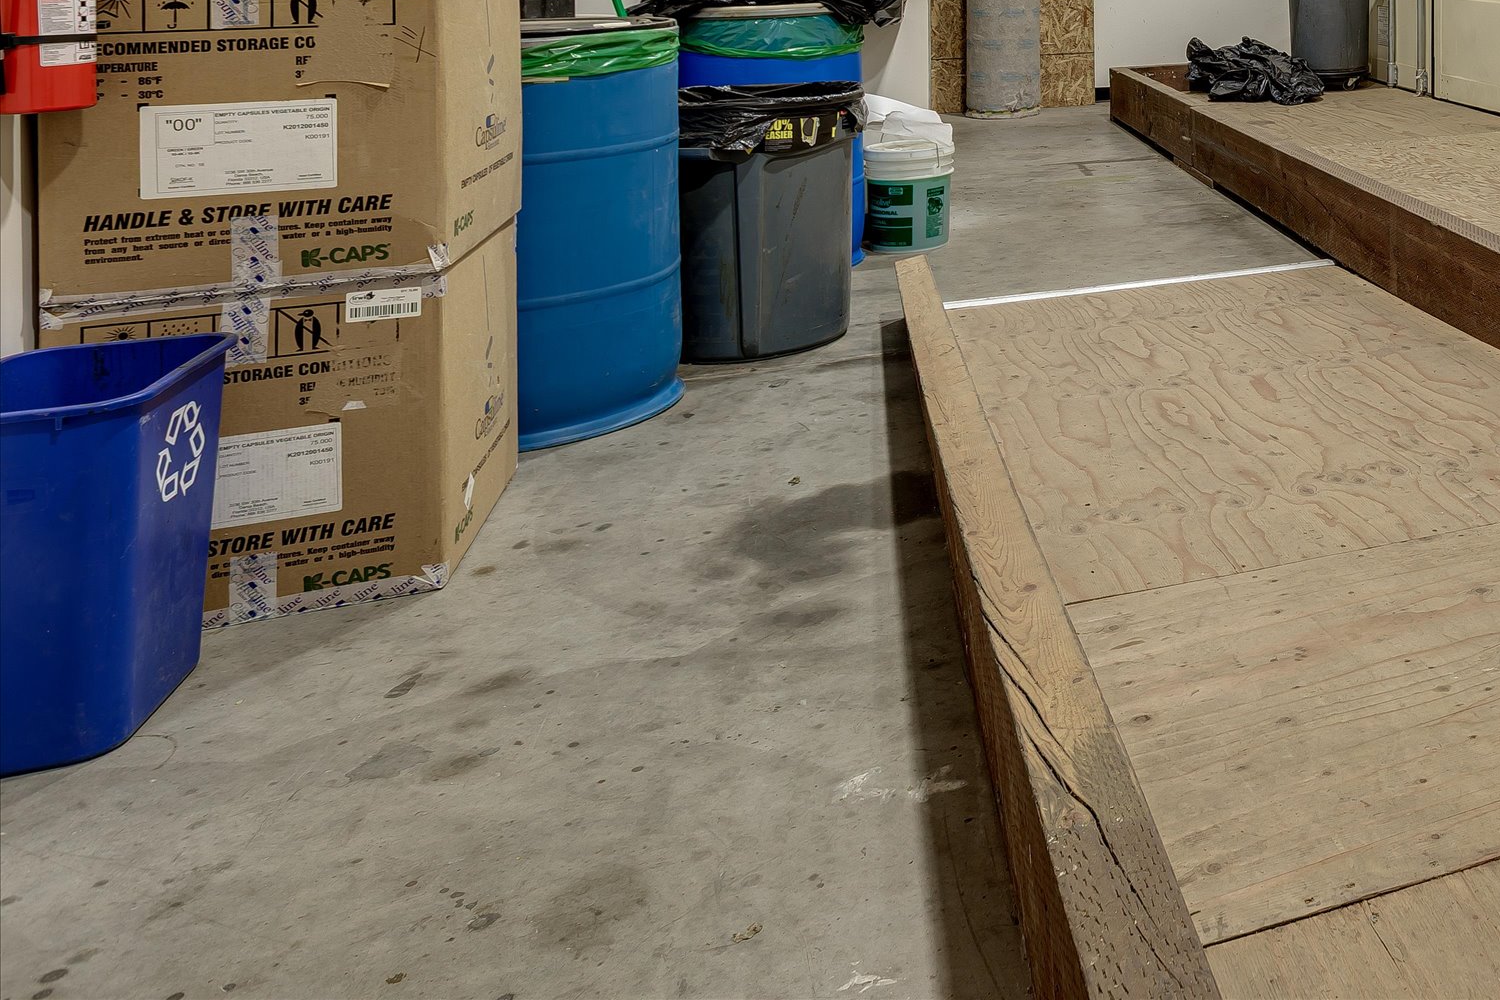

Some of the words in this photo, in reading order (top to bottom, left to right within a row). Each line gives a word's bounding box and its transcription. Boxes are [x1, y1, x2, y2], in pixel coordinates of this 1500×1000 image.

[96, 39, 211, 57] ECOMMENDED
[216, 36, 289, 52] STORAGE
[294, 35, 316, 50] CO
[96, 61, 158, 73] MPERATURE
[237, 109, 270, 117] CAPSULES
[270, 107, 308, 115] VEGETABLE
[308, 105, 330, 113] ORIGIN
[765, 130, 793, 140] EASIER
[83, 209, 172, 232] HANDLE
[178, 208, 194, 226] &
[201, 202, 272, 225] STORE
[278, 198, 332, 218] WITH
[337, 193, 393, 213] CARE
[304, 221, 325, 230] Keep
[328, 218, 367, 227] container
[371, 216, 392, 225] away
[84, 237, 118, 246] Protect
[121, 235, 142, 244] from
[145, 233, 181, 242] extreme
[184, 230, 204, 239] heat
[84, 247, 105, 255] from
[111, 246, 127, 254] any
[133, 243, 153, 251] heat
[158, 241, 188, 250] source
[209, 238, 231, 246] direc
[282, 231, 306, 240] water
[84, 254, 143, 265] environment.
[223, 363, 294, 385] STORAGE
[208, 531, 275, 557] STORE
[281, 522, 335, 546] WITH
[341, 512, 396, 537] CARE
[307, 547, 328, 556] Keep
[331, 539, 370, 551] container
[373, 535, 395, 545] away
[285, 558, 309, 568] water
